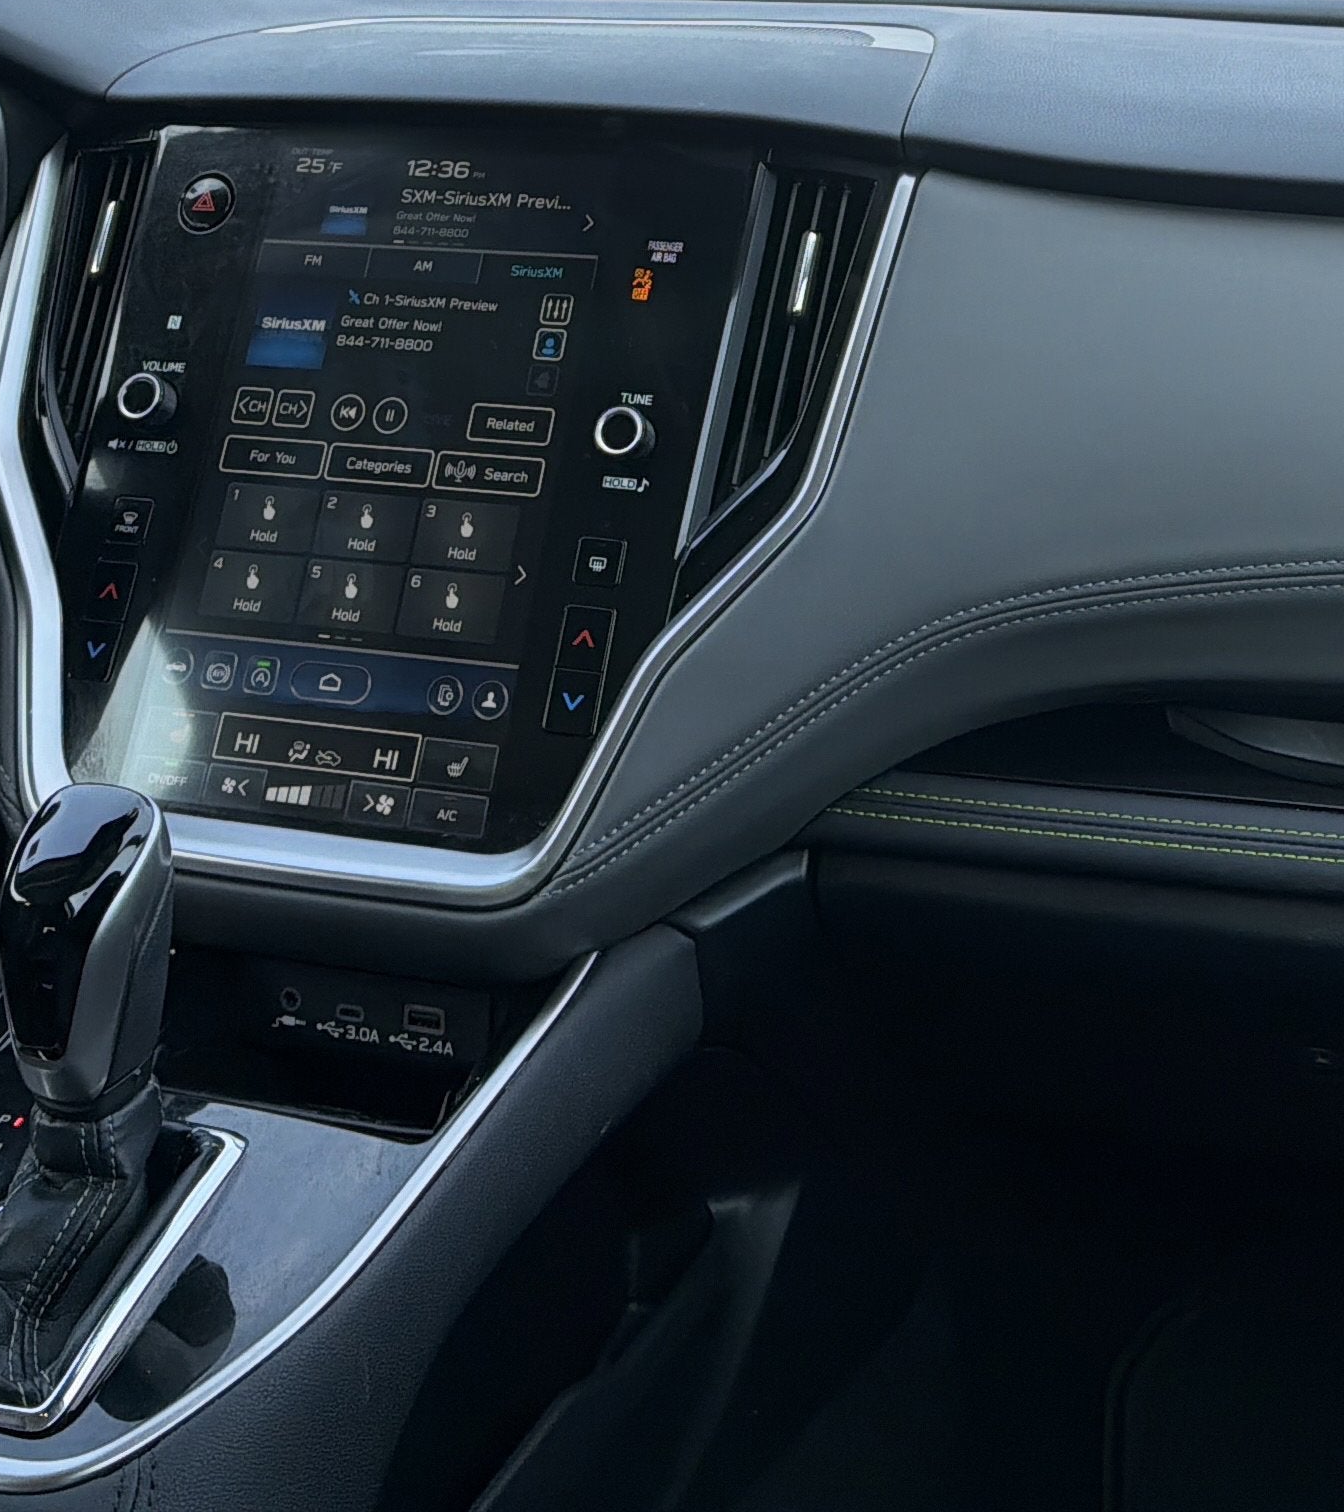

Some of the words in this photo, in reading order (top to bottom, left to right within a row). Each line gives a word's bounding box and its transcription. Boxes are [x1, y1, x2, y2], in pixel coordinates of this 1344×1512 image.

[407, 159, 471, 178] 12:36
[401, 188, 511, 207] SXM-SiriusXM
[517, 195, 571, 211] Previ...
[329, 205, 368, 214] SiriusXM
[396, 211, 423, 220] Great
[426, 213, 449, 222] Offer
[452, 215, 476, 223] Now!
[393, 225, 469, 238] 844-711-8800
[648, 240, 684, 253] PASSENGER
[304, 255, 322, 266] FM
[650, 253, 662, 263] AIR
[663, 254, 677, 264] BAG
[413, 260, 433, 272] AM
[510, 264, 563, 279] SiriusXM
[363, 292, 379, 305] Ch
[384, 295, 446, 309] 1-SiriusXM
[449, 297, 498, 312] Preview
[261, 316, 326, 331] SiriusXM
[341, 315, 374, 329] Great
[378, 317, 409, 331] Offer
[413, 319, 442, 332] Now!
[336, 334, 433, 352] 844-711-8800
[142, 360, 186, 373] VOLUME
[621, 392, 653, 406] TUNE
[248, 400, 267, 413] CH
[279, 401, 298, 415] CH
[486, 417, 535, 433] Related
[135, 440, 166, 452] HOLD
[249, 449, 269, 462] For
[275, 452, 296, 465] You
[346, 456, 412, 475] Categories
[484, 468, 529, 484] Search
[602, 476, 638, 491] HOLD
[232, 489, 240, 501] 1
[326, 497, 338, 509] 2
[425, 505, 437, 518] 3
[250, 529, 278, 543] Hold
[347, 538, 376, 552] Hold
[447, 546, 476, 561] Hold
[213, 557, 224, 569] 4
[311, 565, 323, 579] 5
[410, 575, 422, 588] 6
[233, 598, 262, 612] Hold
[331, 608, 360, 623] Hold
[432, 617, 462, 633] Hold
[233, 732, 261, 753] HI
[372, 748, 399, 770] HI
[147, 774, 188, 787] ON/OFF
[436, 808, 458, 822] A/C
[345, 1025, 380, 1044] 3.0A
[418, 1037, 454, 1056] 2.4A
